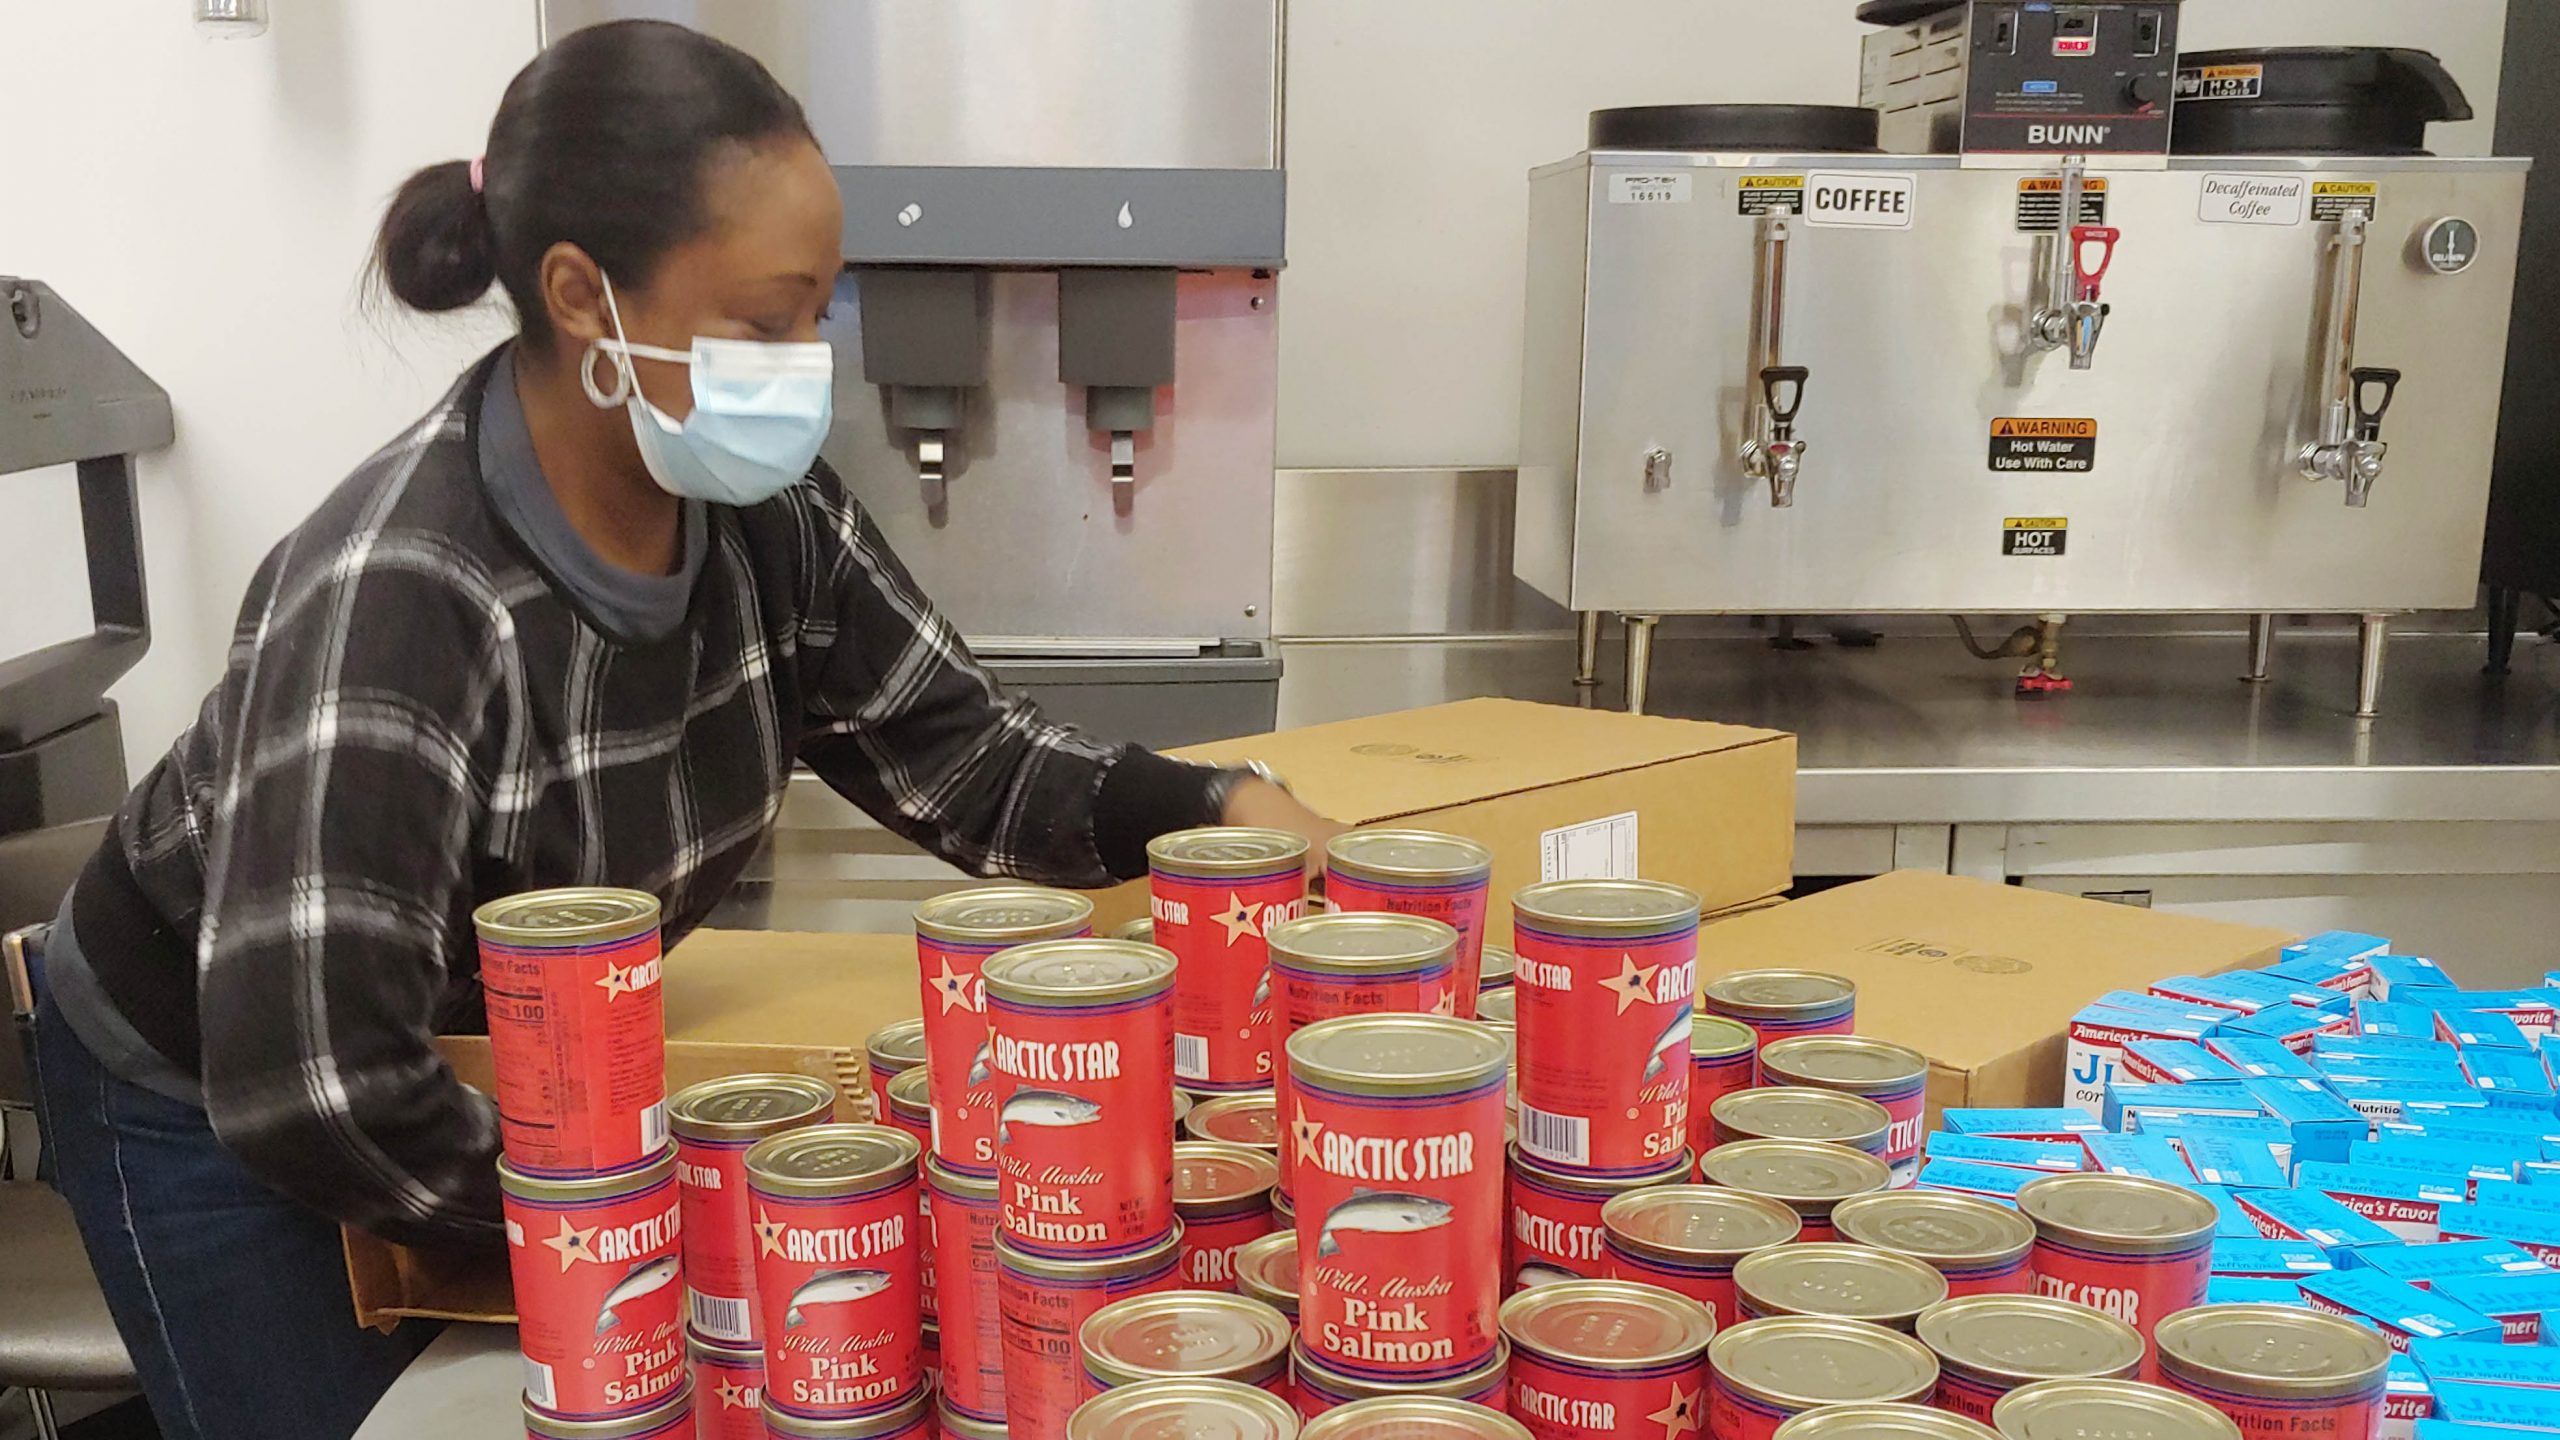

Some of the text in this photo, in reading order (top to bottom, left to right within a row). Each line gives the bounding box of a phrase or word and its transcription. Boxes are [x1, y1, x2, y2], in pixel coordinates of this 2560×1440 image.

[2210, 79, 2251, 89] HOT
[1756, 178, 1799, 188] CAUTION
[2205, 180, 2300, 199] Decaffeinated
[2329, 184, 2372, 194] CAUTION
[1631, 191, 1672, 202] 16619
[1814, 186, 1906, 214] COFFEE
[2228, 201, 2271, 218] Coffee
[2016, 421, 2088, 435] WARNING
[2010, 440, 2074, 453] Hot Water
[1995, 457, 2087, 470] Use With Care
[2014, 531, 2054, 547] HOT
[1164, 899, 1189, 926] STAR
[1386, 897, 1441, 912] Nutrition
[507, 959, 541, 975] Facts
[1538, 962, 1572, 991] STAR
[1344, 989, 1385, 1006] Facts
[513, 1004, 544, 1020] 100
[996, 1034, 1121, 1081] ARCTIC STAR
[2076, 1089, 2103, 1103] cor
[2352, 1103, 2401, 1115] Nutritio
[1322, 1131, 1474, 1182] ARCTIC STAR
[693, 1166, 722, 1190] STAR
[1014, 1182, 1083, 1216] Pink
[1003, 1203, 1109, 1243] Salmon
[2388, 1202, 2437, 1222] Favor
[600, 1214, 664, 1264] ARCTIC
[787, 1214, 905, 1263] ARCTIC STAR
[1515, 1205, 1603, 1261] ARCTIC STA
[1193, 1248, 1237, 1283] ARC
[1032, 1290, 1069, 1308] Facts
[2080, 1284, 2140, 1326] STAR
[1343, 1297, 1430, 1332] Pink
[1036, 1337, 1072, 1354] 100
[1323, 1321, 1455, 1363] Salmon
[624, 1338, 679, 1378] Pink
[810, 1352, 880, 1380] Pink
[603, 1361, 686, 1405] Salmo
[792, 1375, 898, 1406] Salmon
[1520, 1383, 1616, 1431] ARCTIC STAR
[2290, 1416, 2336, 1433] Facts
